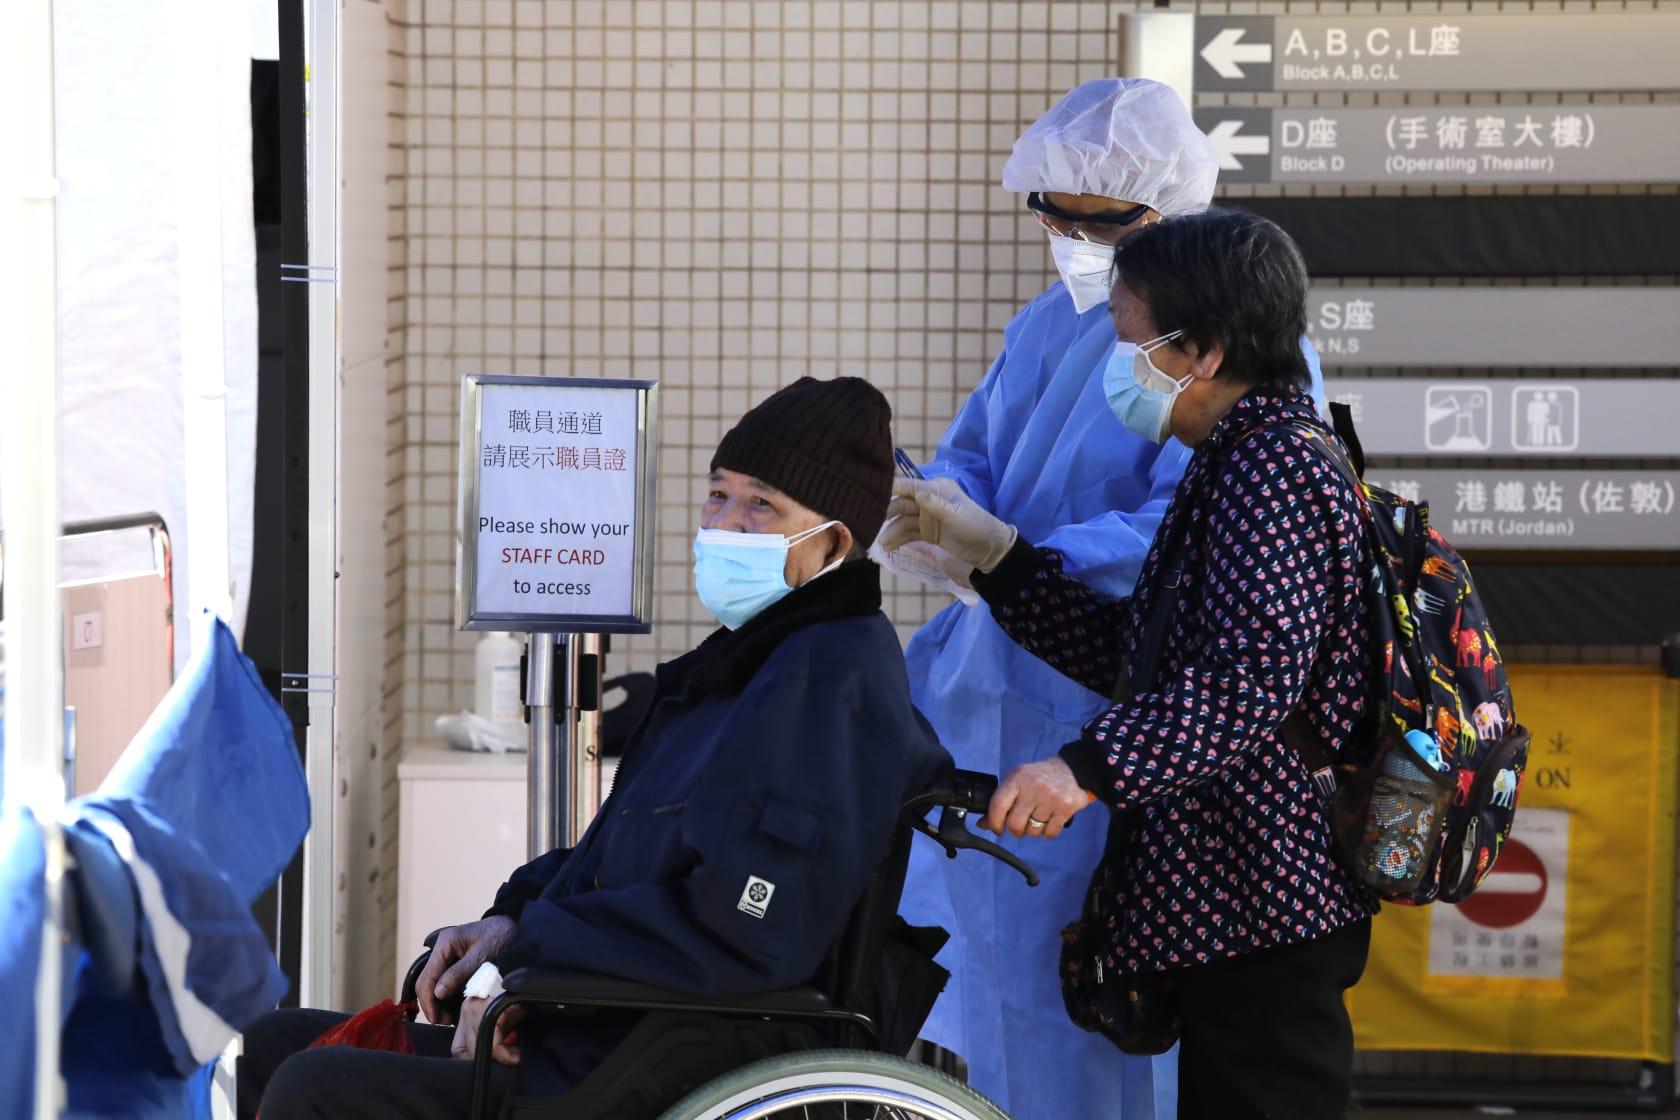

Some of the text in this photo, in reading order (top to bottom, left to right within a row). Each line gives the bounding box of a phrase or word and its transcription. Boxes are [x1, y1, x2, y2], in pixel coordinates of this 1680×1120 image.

[1283, 64, 1399, 81] Block A,B,C,L
[1280, 117, 1338, 149] D座
[1280, 154, 1555, 175] Block D (Operating Theater)
[508, 409, 603, 435] 職員通道
[483, 444, 627, 471] 請展示職員證
[479, 517, 629, 539] Please show your
[1452, 518, 1575, 536] MTR (Jordan)
[502, 547, 605, 565] STAFF CARD
[513, 579, 591, 595] to access
